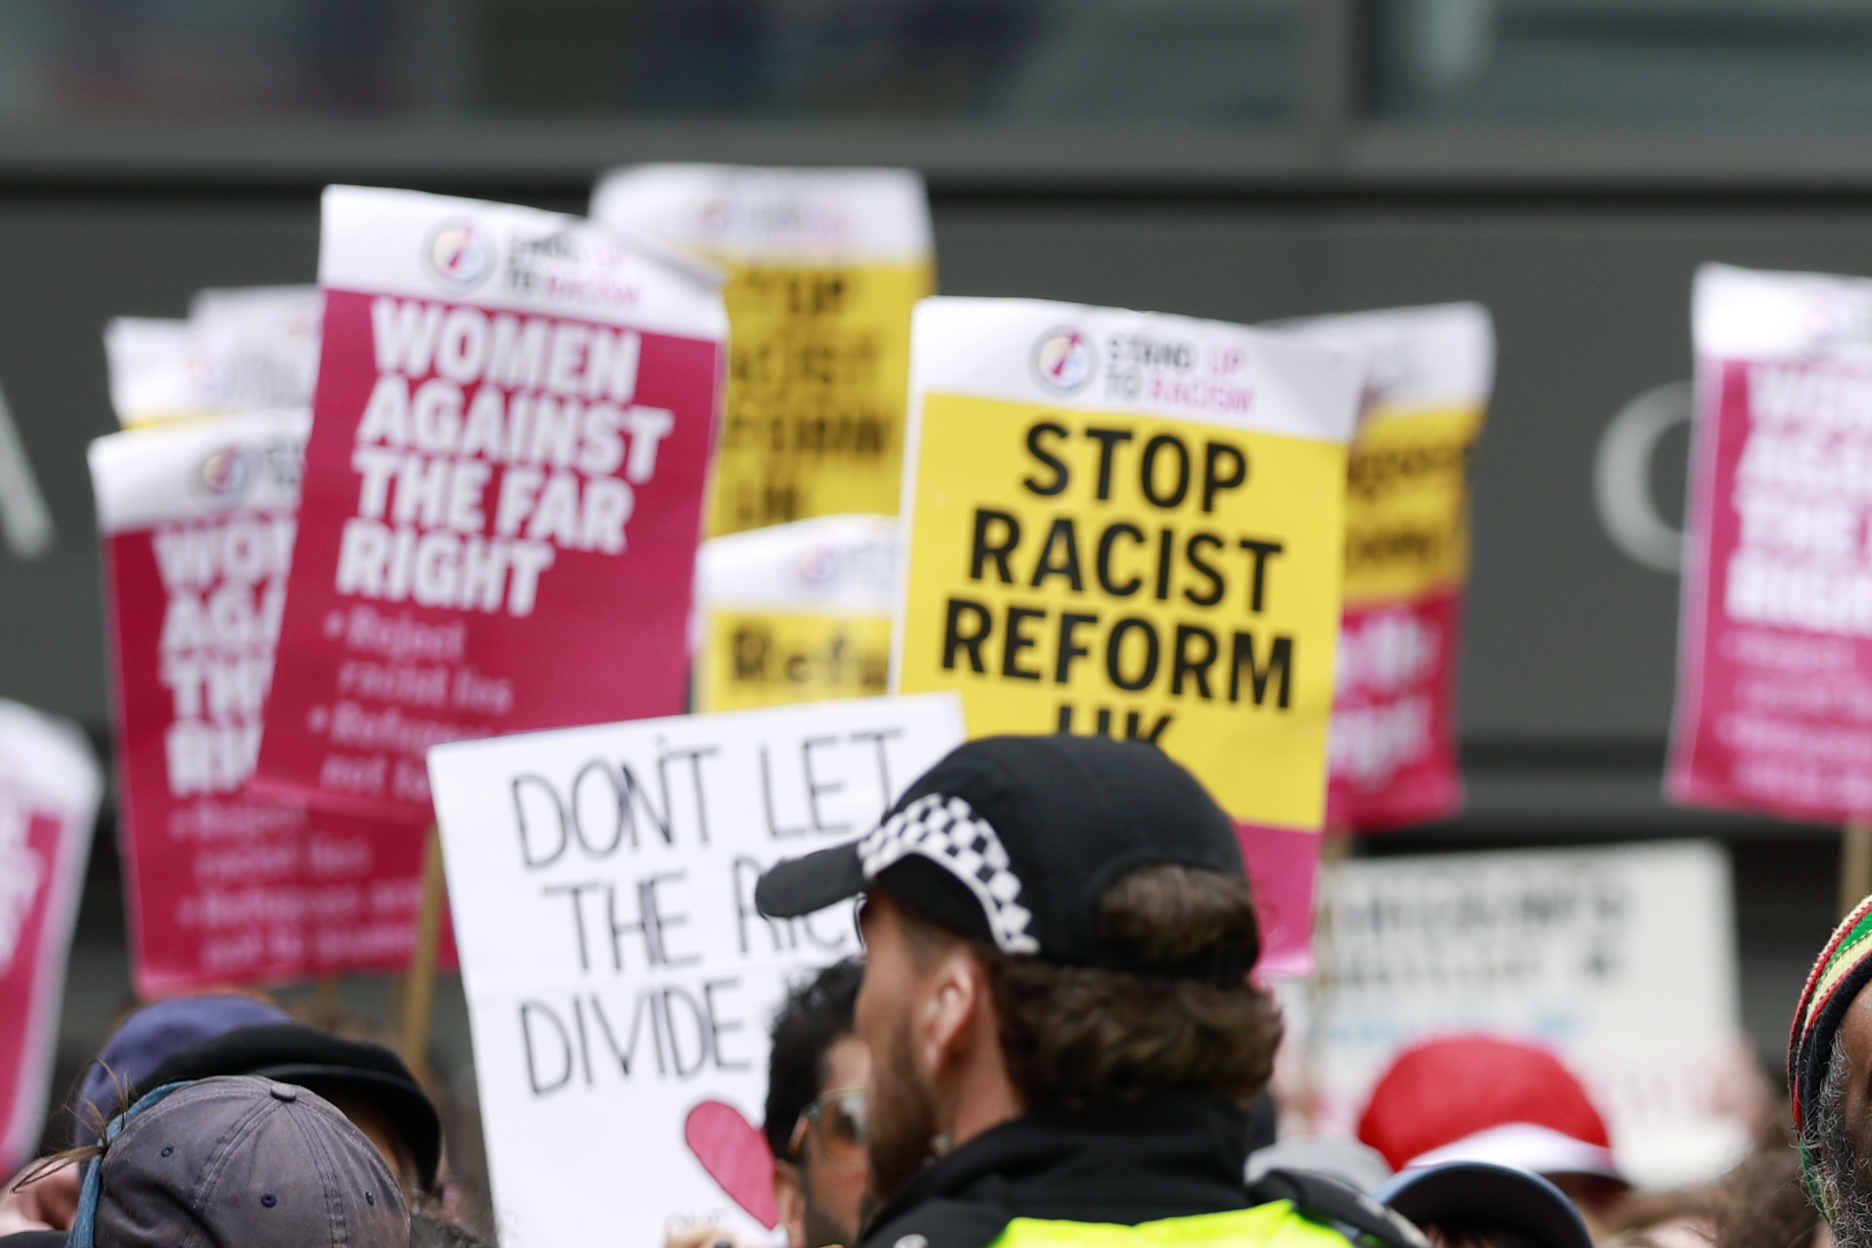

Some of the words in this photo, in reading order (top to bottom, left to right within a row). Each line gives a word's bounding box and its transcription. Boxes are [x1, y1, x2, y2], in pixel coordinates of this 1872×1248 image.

[369, 296, 643, 403] WOMEN
[355, 373, 676, 486] AGAINST
[1022, 420, 1248, 515] STOP
[350, 444, 492, 534] THE
[493, 466, 638, 557] FAR
[334, 516, 556, 618] RIGHT
[967, 506, 1284, 615] RACIST
[940, 595, 1295, 710] REFORM
[511, 734, 721, 871] DON'T
[760, 727, 906, 838] LET
[541, 870, 705, 976] THE
[520, 976, 754, 1096] DIVIDE
